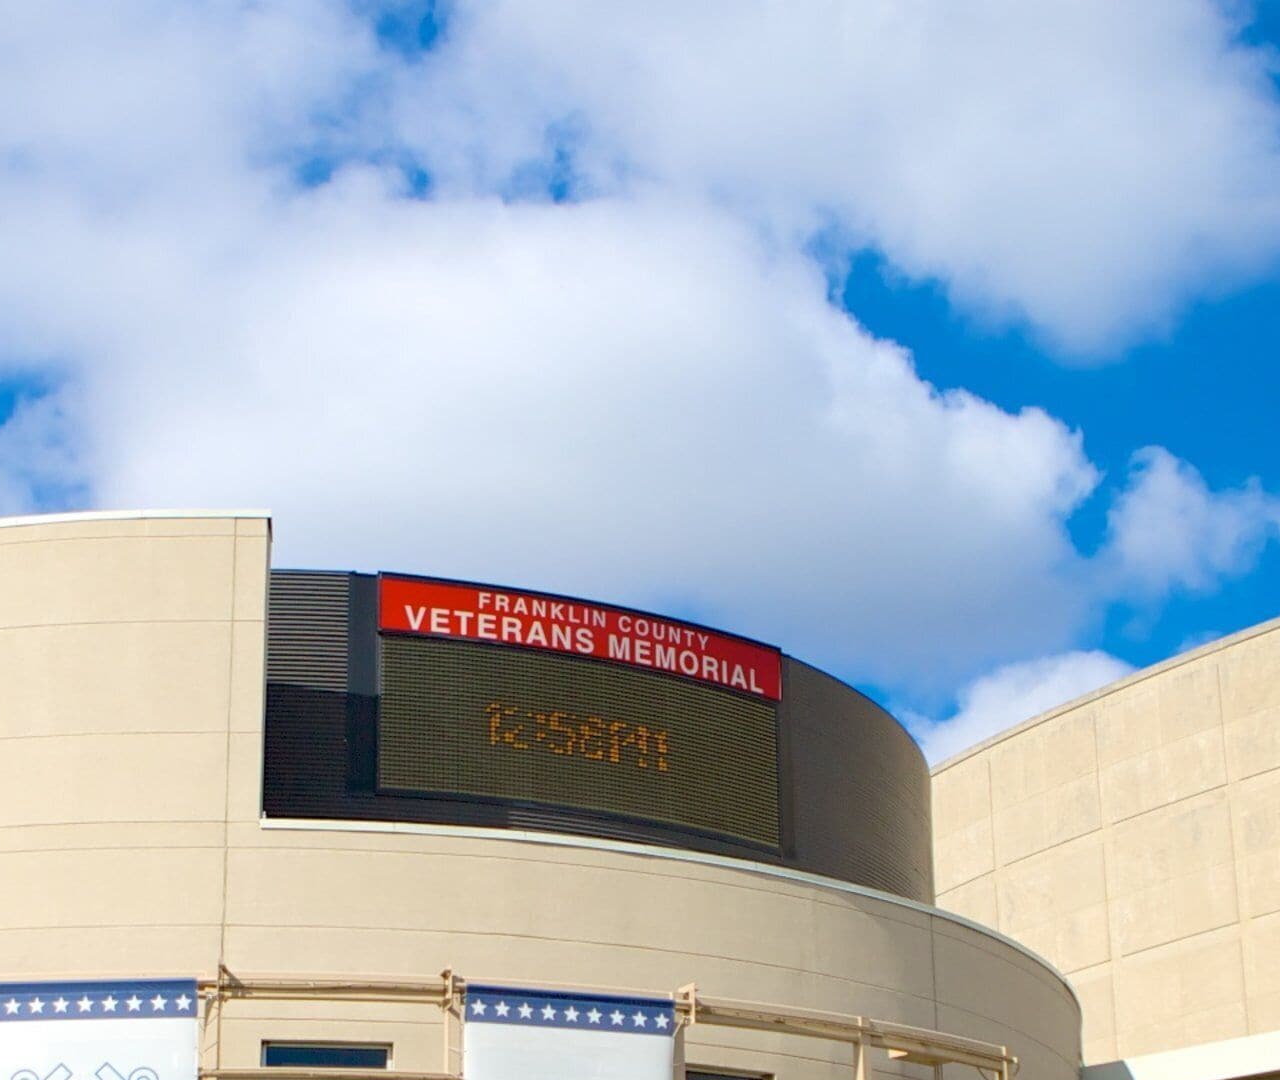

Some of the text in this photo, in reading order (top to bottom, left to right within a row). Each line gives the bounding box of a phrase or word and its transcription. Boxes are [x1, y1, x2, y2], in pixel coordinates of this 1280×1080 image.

[404, 604, 765, 695] VETERANS MEMORIAL
[478, 591, 710, 651] FRANKLIN COUNTY
